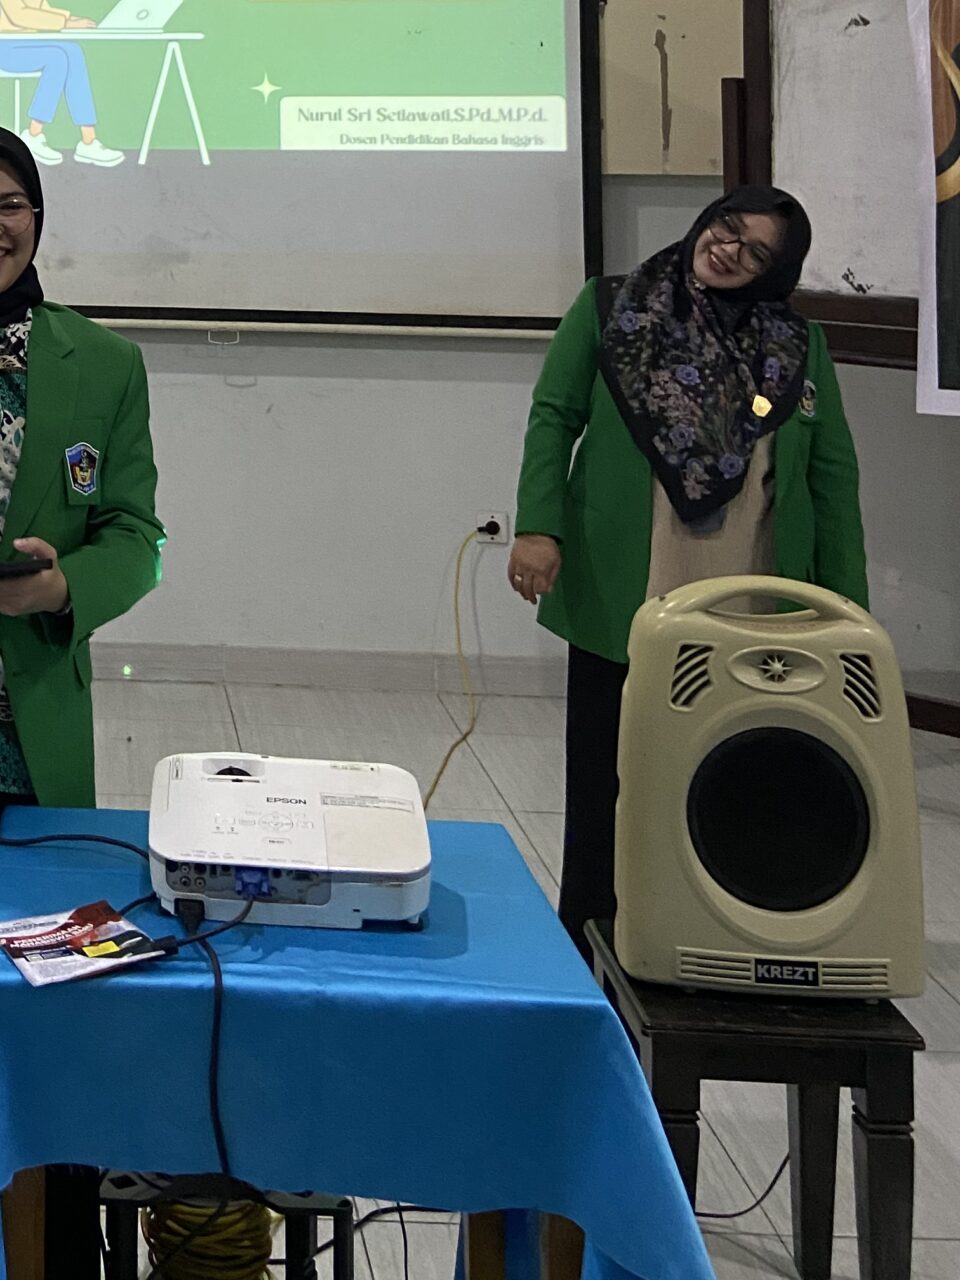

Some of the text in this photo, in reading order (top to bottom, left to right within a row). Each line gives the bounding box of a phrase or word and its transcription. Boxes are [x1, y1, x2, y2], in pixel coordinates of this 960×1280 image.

[297, 107, 342, 122] Nurul
[347, 107, 372, 122] Sri
[339, 133, 545, 148] Dosen Pendidikan Bahasa Inggris
[266, 796, 307, 805] EPSON
[757, 964, 816, 981] KREZT
